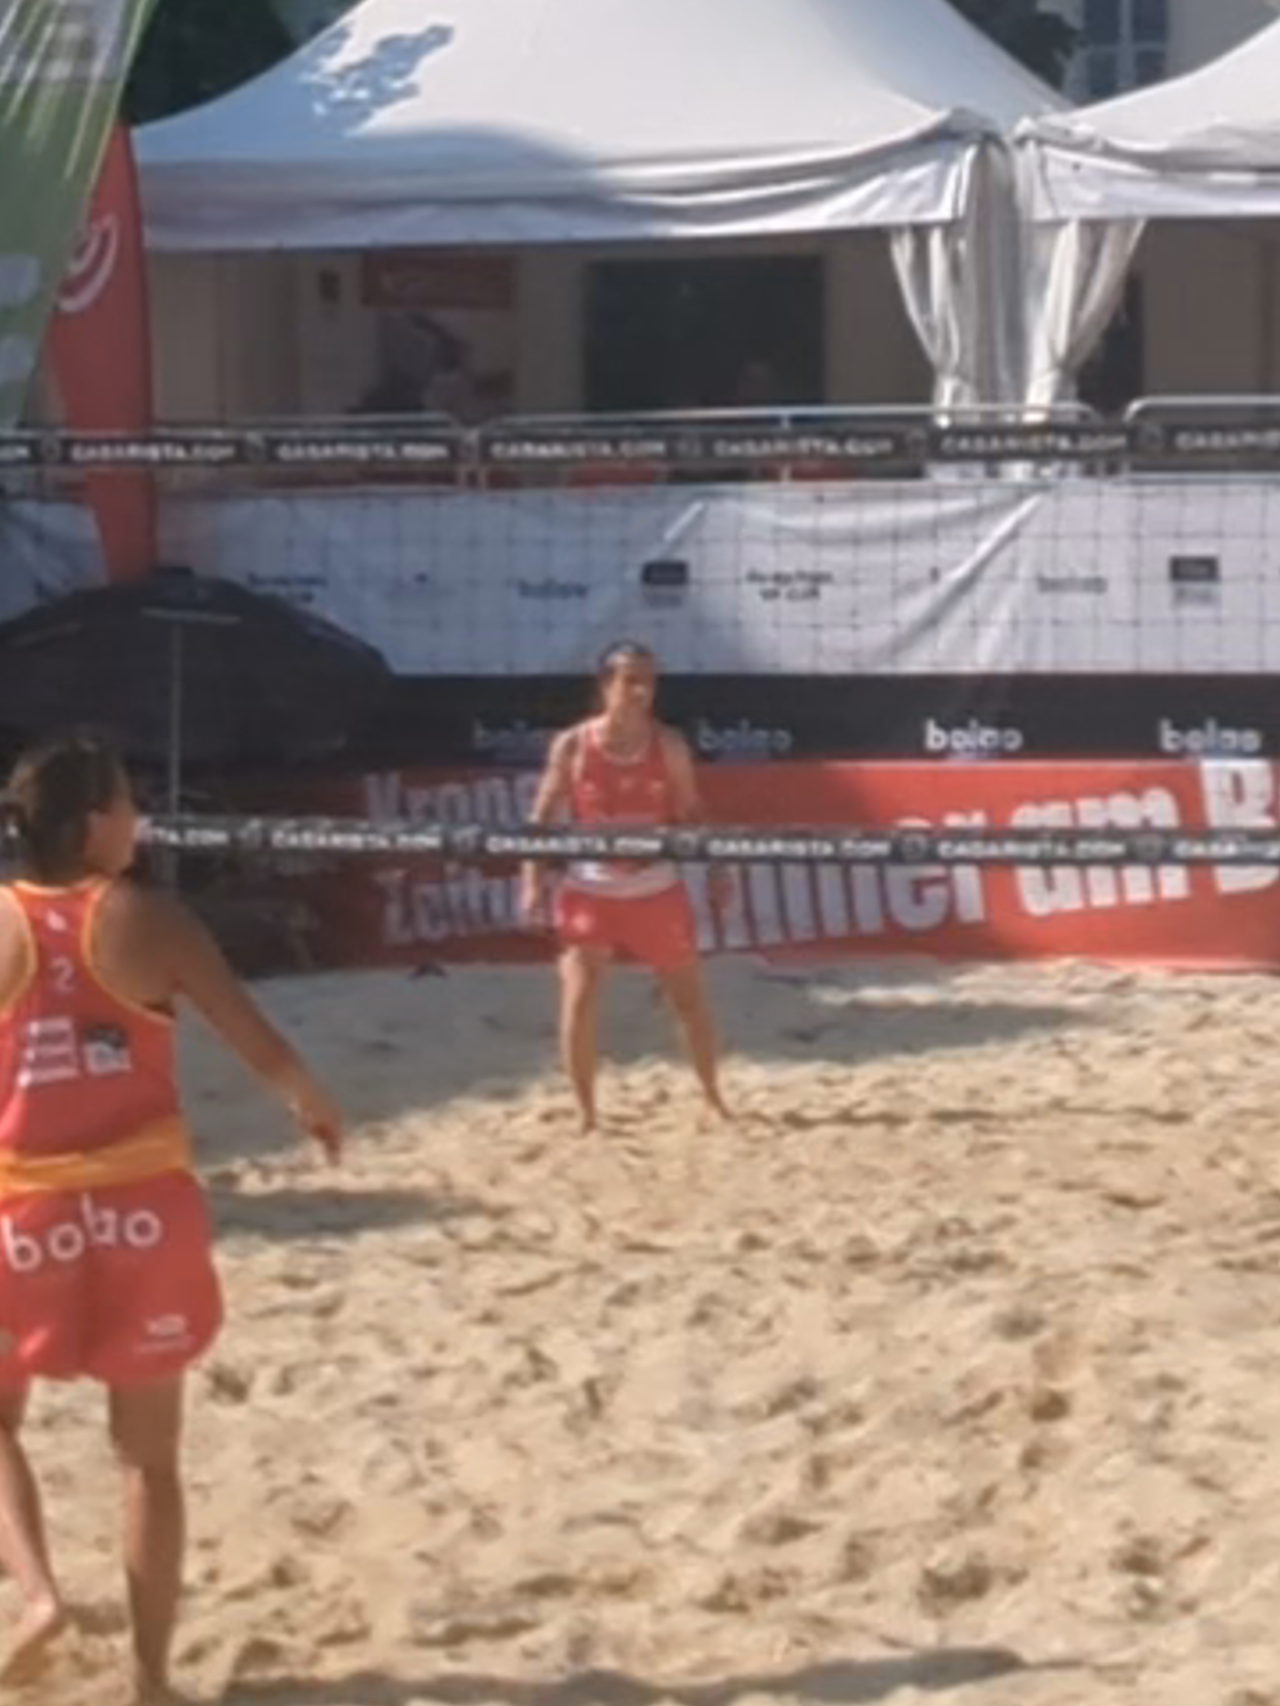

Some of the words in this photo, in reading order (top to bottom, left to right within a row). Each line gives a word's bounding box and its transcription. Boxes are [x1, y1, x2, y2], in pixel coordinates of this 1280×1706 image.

[1159, 717, 1263, 754] bolao
[708, 836, 892, 858] CASARISTA.COM
[937, 837, 1126, 859] CASARISTA.COM
[1008, 786, 1190, 918] am
